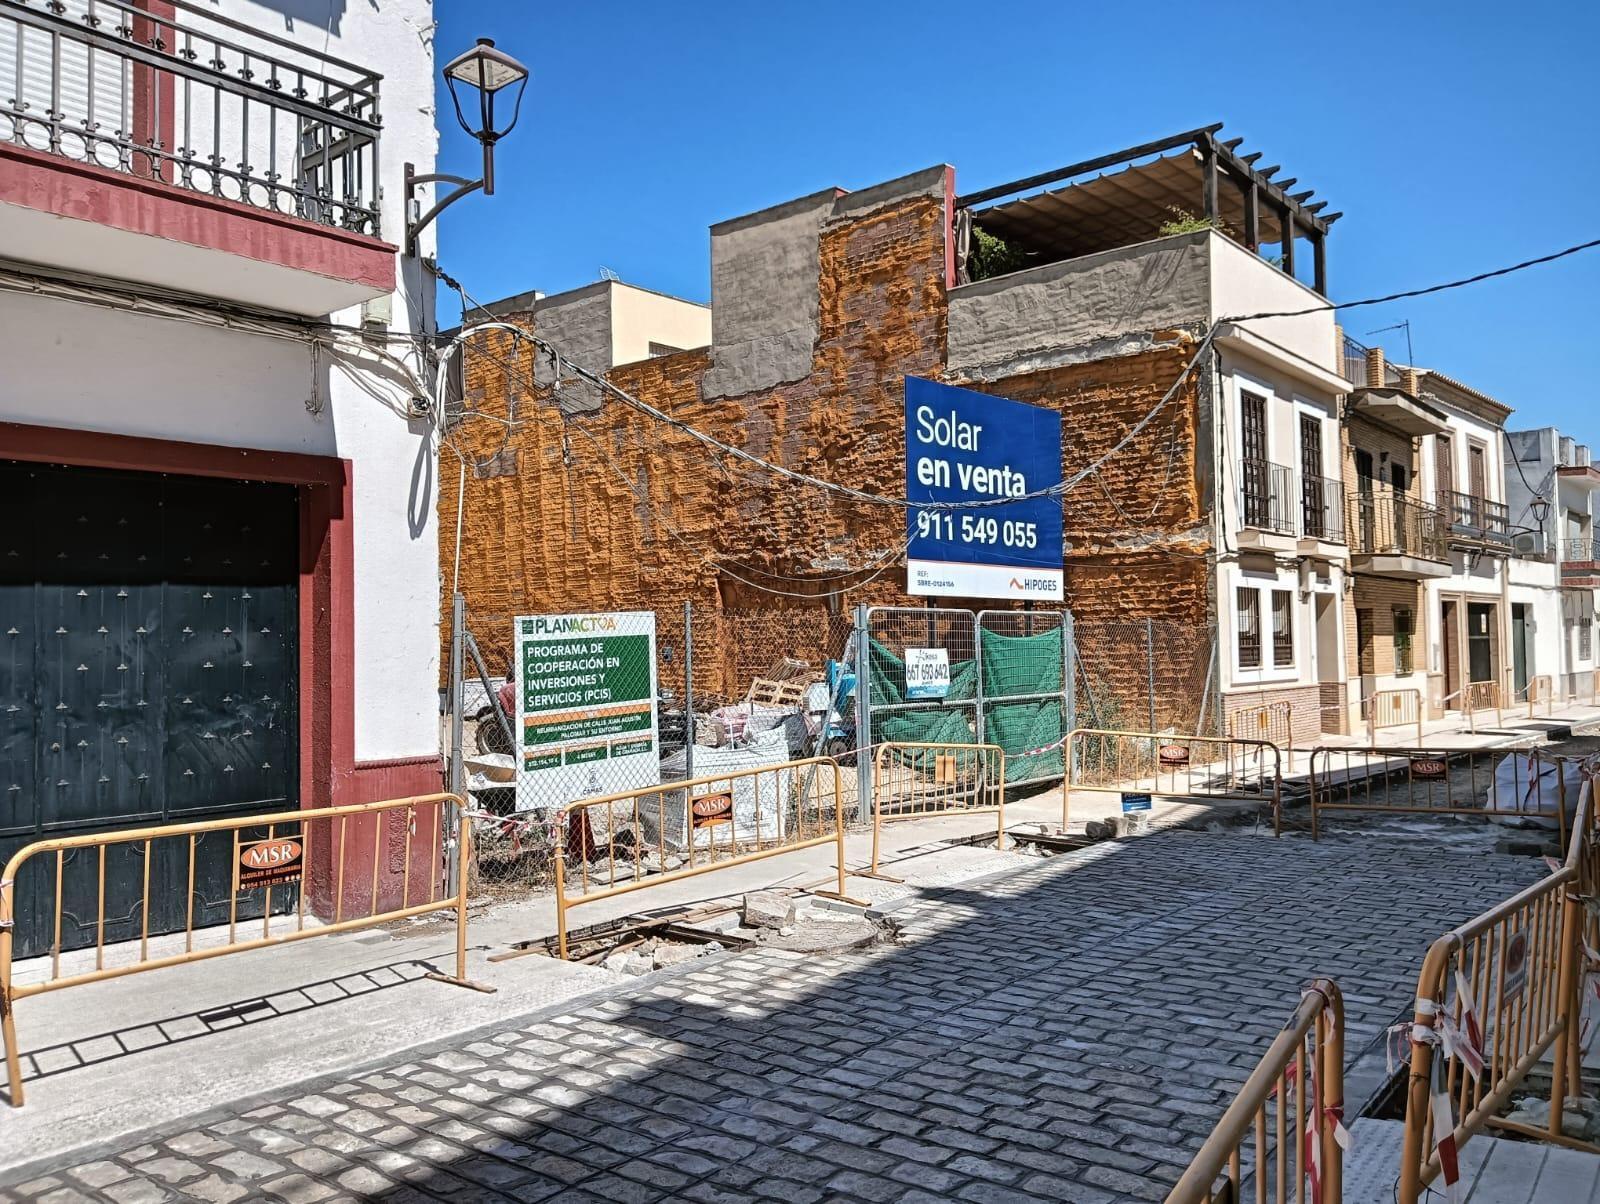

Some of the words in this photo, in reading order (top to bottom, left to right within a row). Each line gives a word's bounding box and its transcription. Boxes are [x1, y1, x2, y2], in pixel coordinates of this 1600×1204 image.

[916, 405, 983, 452] Solar
[917, 456, 950, 489] en
[957, 462, 1026, 498] venta
[917, 510, 954, 541] 911
[962, 515, 998, 544] 549
[1003, 520, 1037, 549] 055
[1024, 578, 1056, 591] HIPOGES
[527, 645, 588, 658] PROGRAMA
[590, 643, 604, 654] DE
[528, 657, 604, 674] COOPERACIÓN
[606, 657, 620, 668] EN
[528, 674, 596, 690] INVERSIONES
[598, 673, 606, 684] Y
[528, 692, 582, 707] SERVICIOS
[584, 688, 611, 702] (PCIS)
[1164, 748, 1184, 757] MSR
[1416, 762, 1440, 772] MSR
[698, 798, 725, 813] MSR
[250, 844, 293, 866] MSR
[240, 870, 264, 880] ALQUILER
